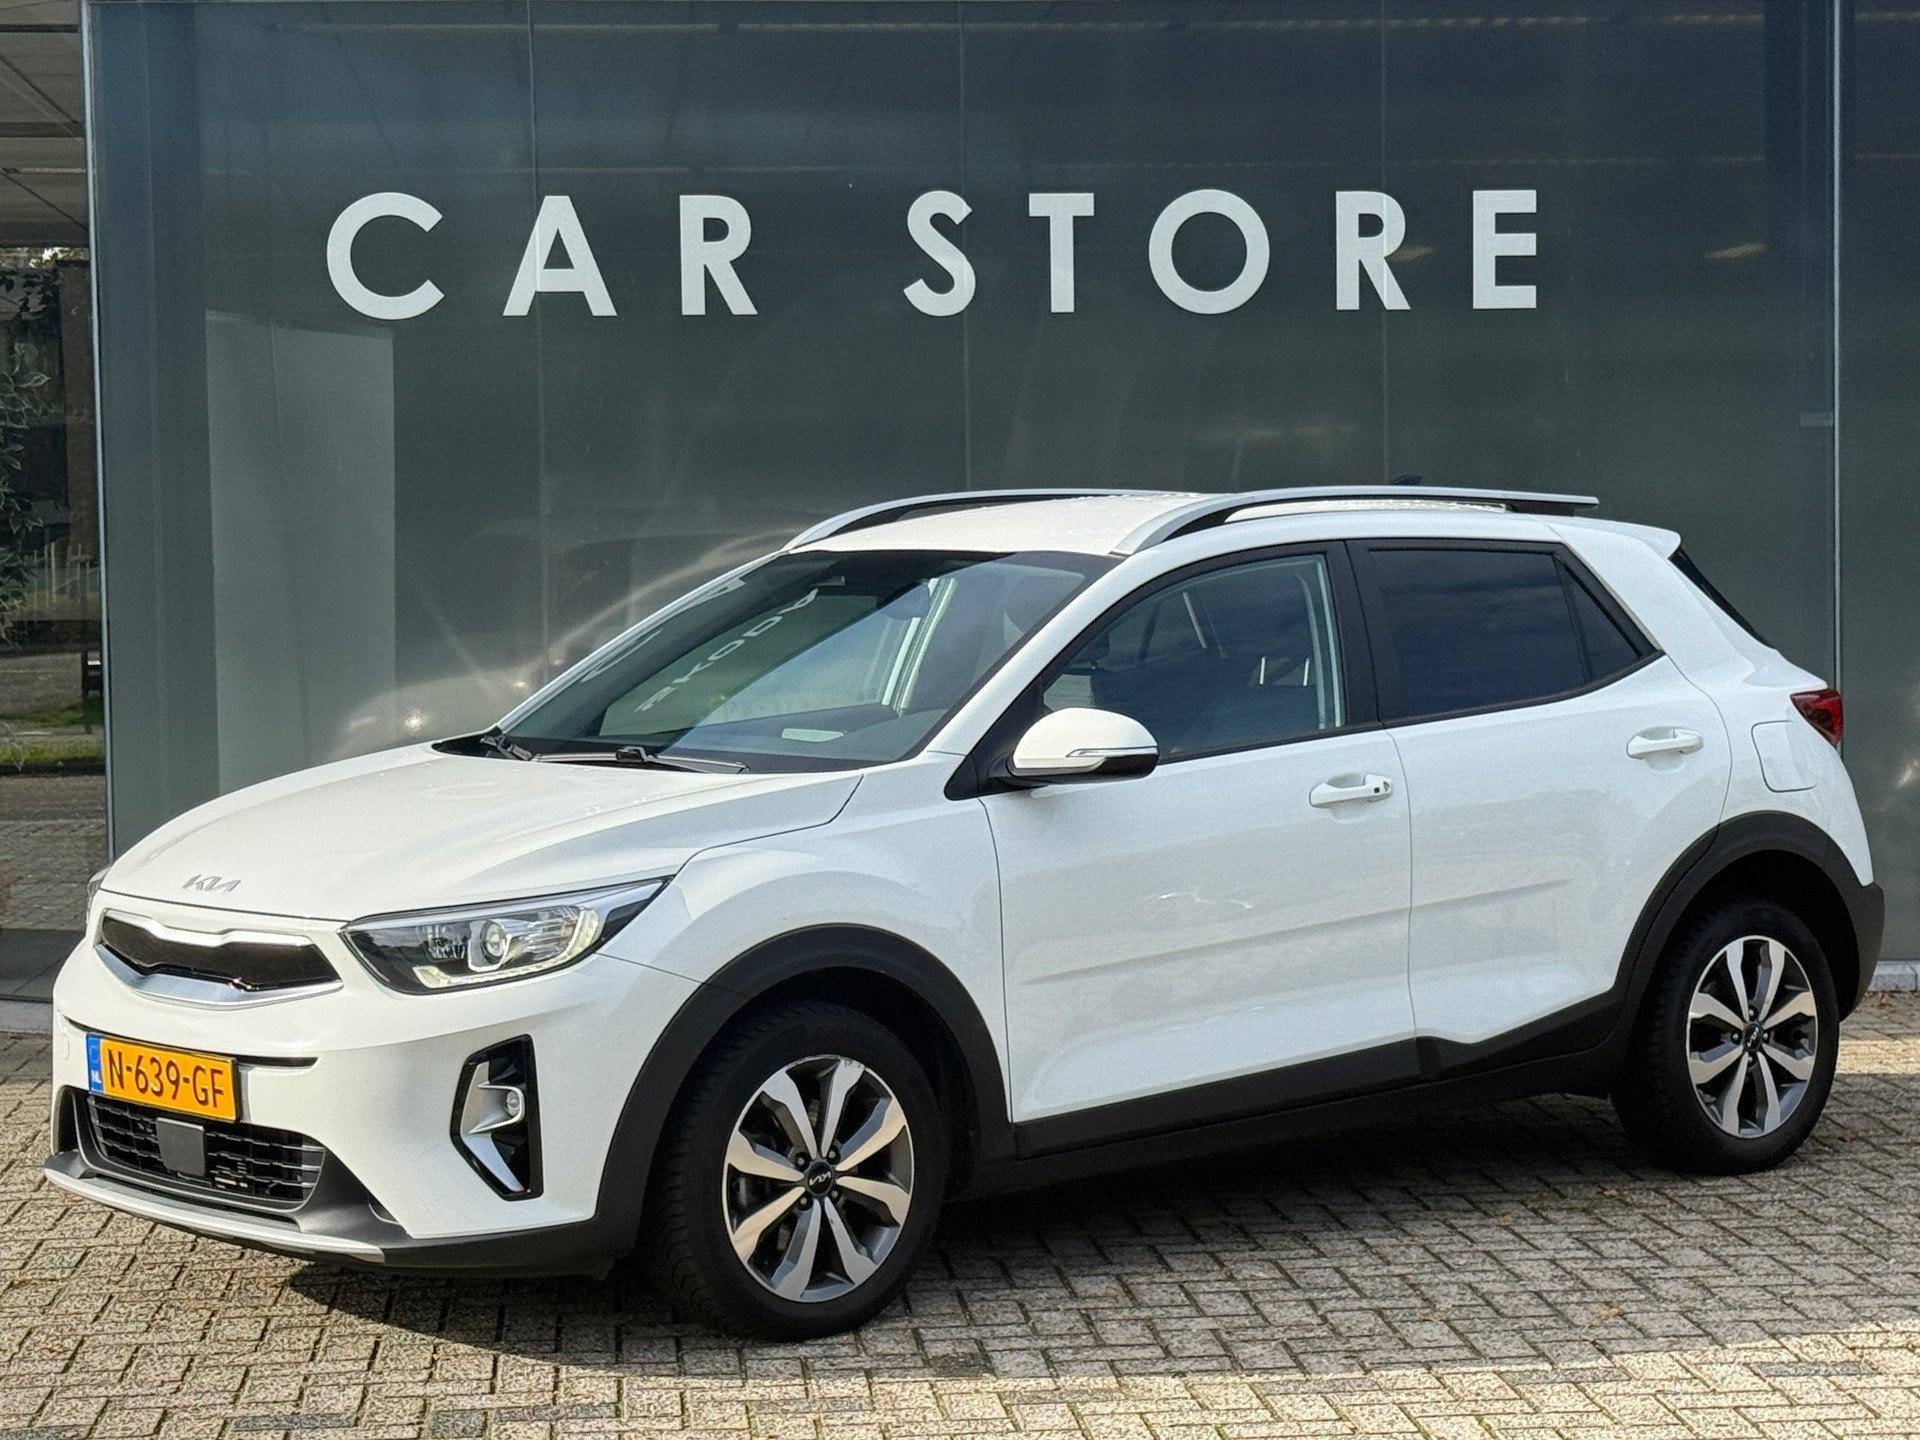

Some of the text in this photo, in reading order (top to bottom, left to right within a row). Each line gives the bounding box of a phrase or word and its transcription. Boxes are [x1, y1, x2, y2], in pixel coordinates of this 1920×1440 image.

[327, 189, 1536, 319] CAR STORE
[182, 874, 241, 892] KIA
[90, 1069, 102, 1084] NL
[108, 1048, 224, 1108] N-639-GF
